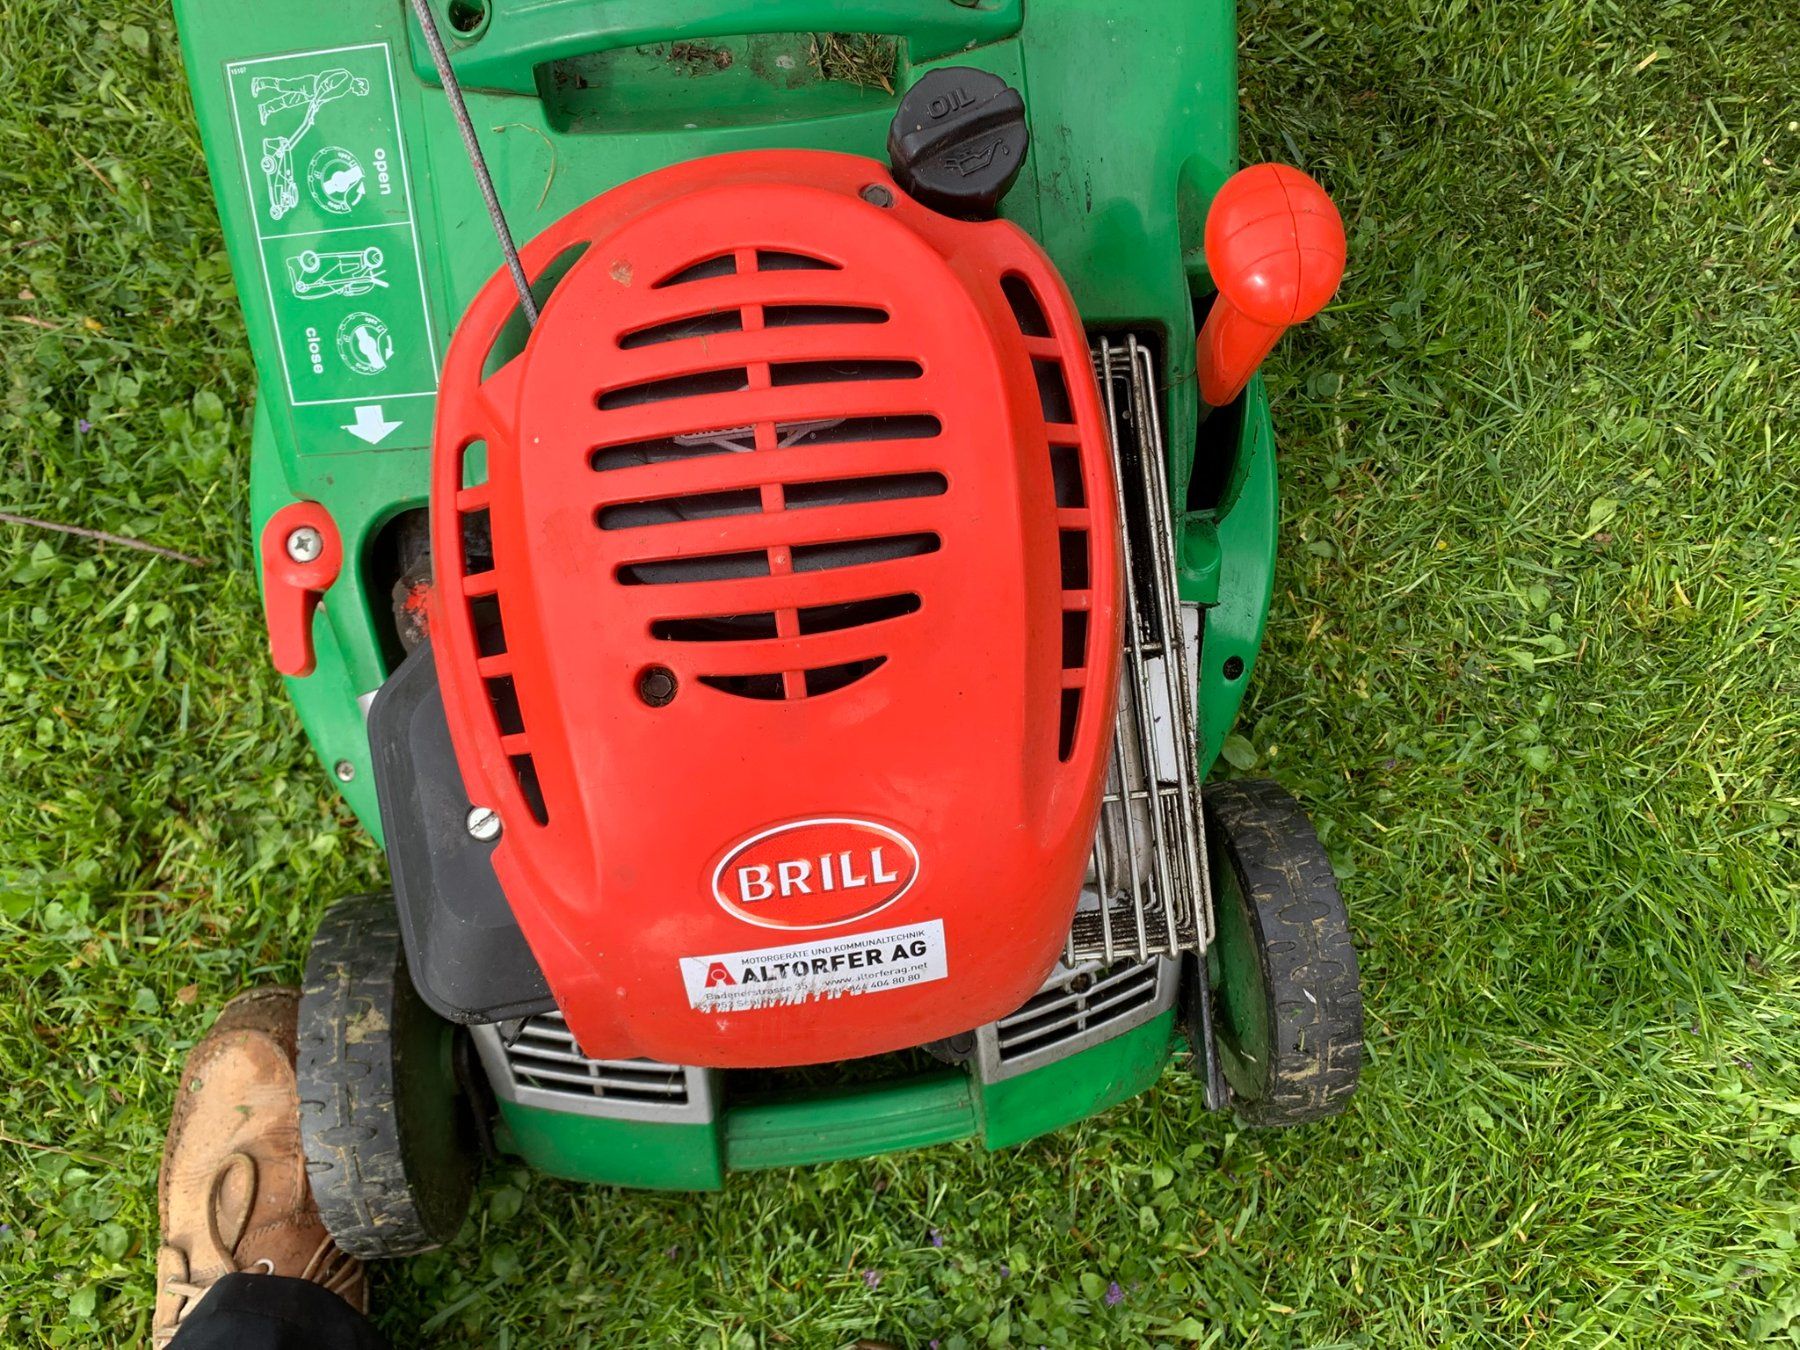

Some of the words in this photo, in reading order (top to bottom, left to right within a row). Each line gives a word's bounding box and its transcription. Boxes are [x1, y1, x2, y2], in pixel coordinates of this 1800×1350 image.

[927, 87, 976, 119] OIL
[373, 148, 391, 195] open
[306, 327, 323, 374] close
[737, 846, 898, 902] BRILL
[742, 948, 884, 984] ALTORFER
[891, 940, 927, 962] AG
[811, 946, 832, 956] UND
[834, 930, 925, 953] KOMMUNALTECHNIK
[871, 978, 889, 988] 404
[892, 976, 905, 984] 80
[908, 973, 920, 982] 80
